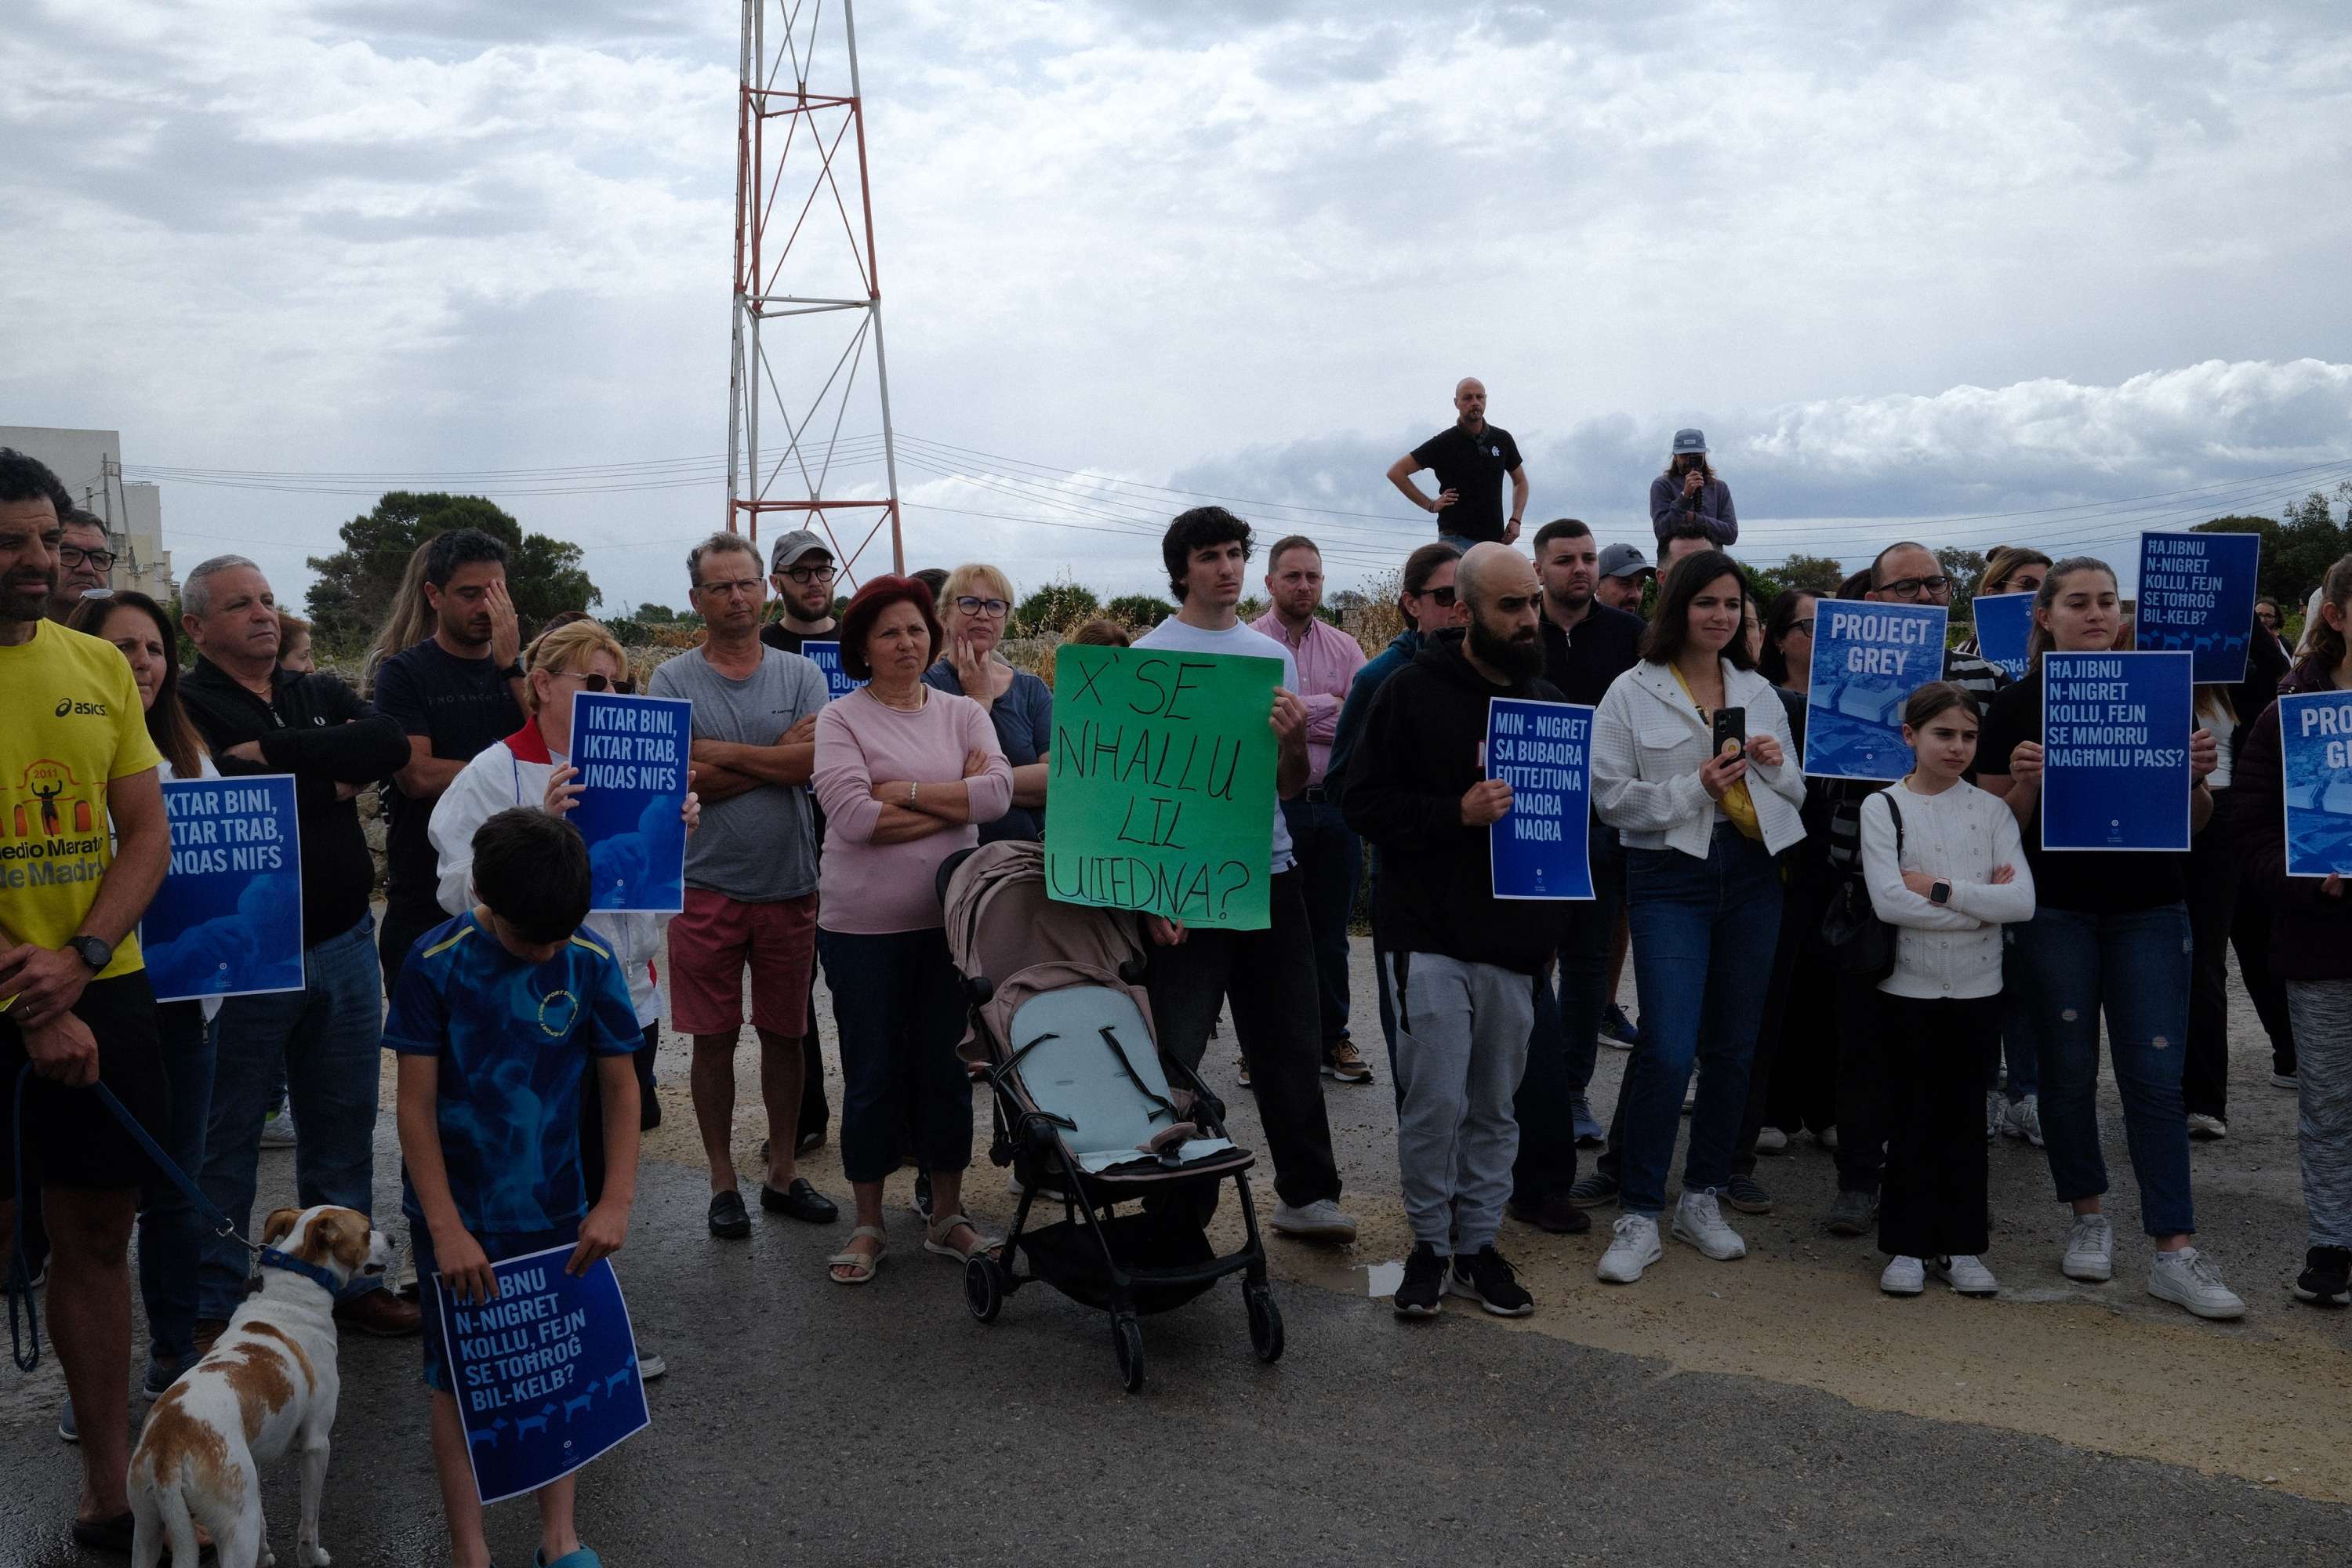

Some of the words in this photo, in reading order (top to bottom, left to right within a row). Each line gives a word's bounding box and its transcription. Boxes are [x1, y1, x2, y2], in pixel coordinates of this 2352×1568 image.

[2167, 540, 2205, 556] JIBNU
[2147, 557, 2209, 574] N-NIGRET
[2145, 574, 2188, 592] KOLLU,
[2191, 576, 2223, 591] FEJN
[2143, 591, 2160, 606] SE
[1831, 613, 1931, 644] PROJECT
[2143, 608, 2208, 626] BIL-KELB?
[809, 652, 837, 669] MIN
[1847, 647, 1910, 676] GREY
[2074, 660, 2122, 679] JIBNU
[2049, 682, 2129, 701] N-NIGRET
[74, 702, 108, 717] asics
[2049, 704, 2105, 726] KOLLU,
[2108, 704, 2146, 723] FEJN
[589, 706, 637, 732] IKTAR
[641, 710, 678, 738] BINI,
[1495, 712, 1524, 735] MIN
[1537, 716, 1588, 740] NIGRET
[2048, 726, 2069, 746] SE
[2072, 726, 2148, 746] MMORRU
[583, 735, 632, 760] IKTAR
[636, 738, 680, 766] TRAB,
[1495, 739, 1515, 760] SA
[1518, 741, 1583, 766] BUBAQRA
[2134, 749, 2185, 768] PASS?
[2327, 739, 2352, 769] G
[34, 768, 59, 779] 2011
[584, 764, 637, 790] INQAS
[640, 767, 677, 791] NIFS
[162, 792, 219, 817] KTAR
[225, 789, 278, 815] BINI,
[1515, 793, 1562, 816] NAQRA
[169, 820, 218, 846] TAR
[222, 817, 285, 844] TRAB,
[1117, 796, 1185, 848] LIL
[1515, 818, 1562, 842] NAQRA
[0, 842, 45, 860] edio
[169, 848, 228, 876] NQAS
[233, 845, 283, 872] NIFS
[455, 1292, 559, 1335] N-NIGRET
[459, 1328, 536, 1361] KOLLU,
[538, 1308, 586, 1344] FEJN
[465, 1363, 495, 1386] SE
[470, 1363, 575, 1412] BIL-KELB?
